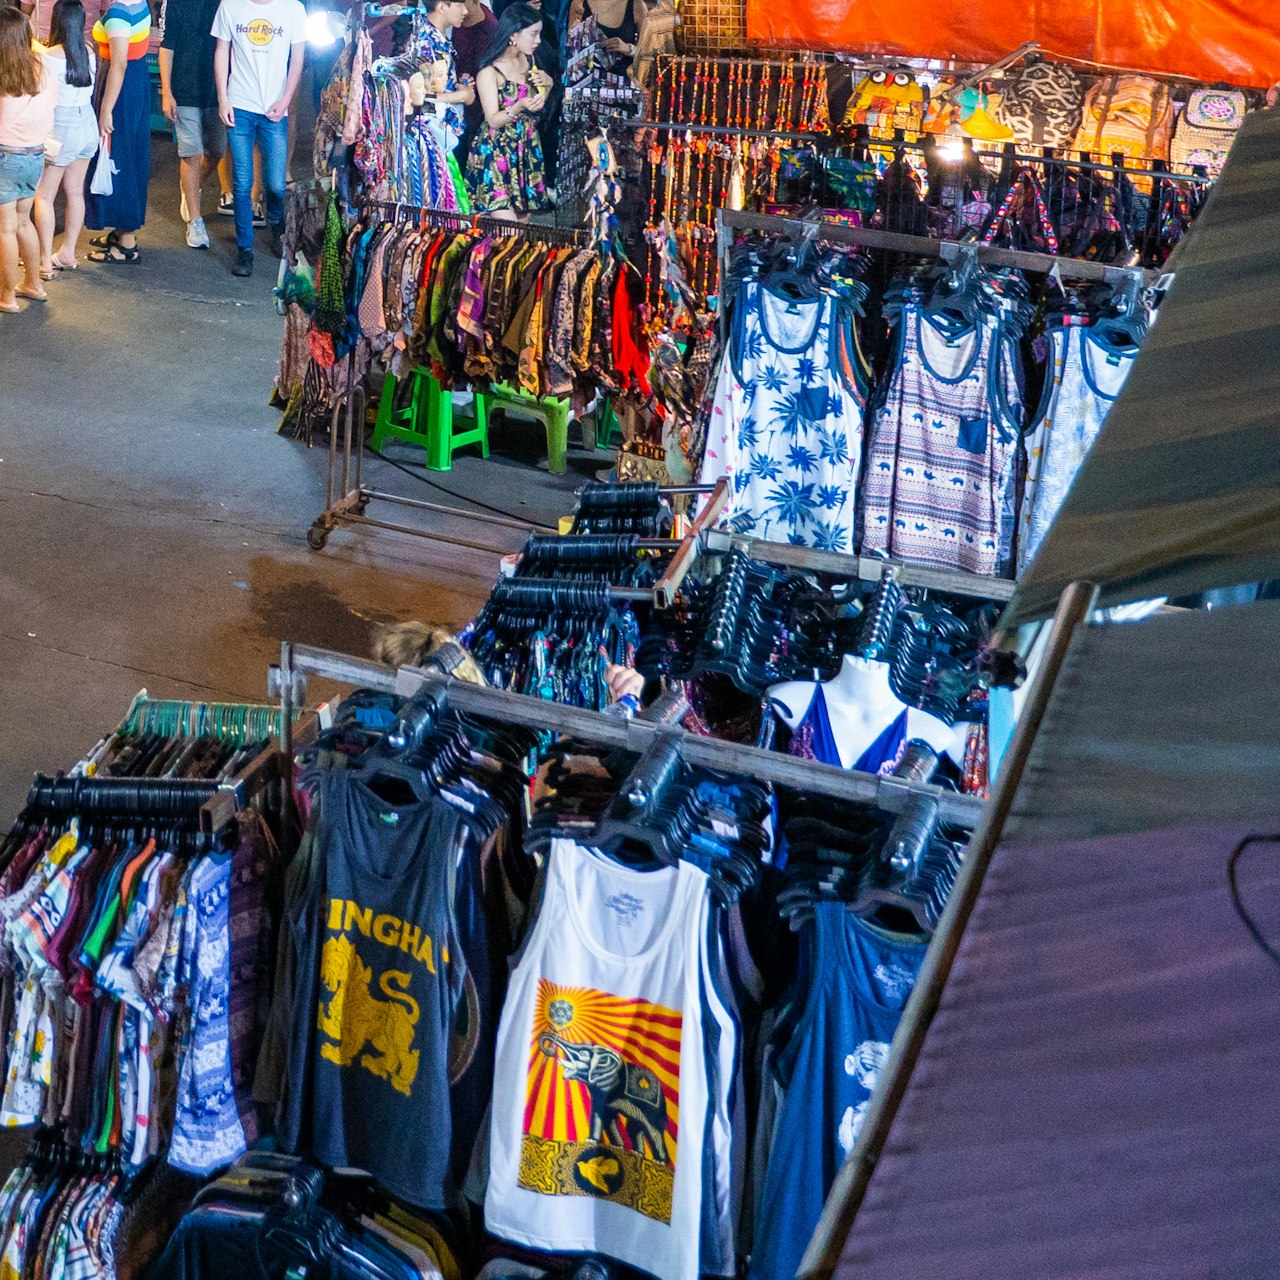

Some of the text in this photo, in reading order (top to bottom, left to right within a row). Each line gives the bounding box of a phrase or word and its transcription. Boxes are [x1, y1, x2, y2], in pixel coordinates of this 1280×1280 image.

[235, 23, 284, 38] Hard Rock
[327, 898, 437, 975] INGHA
